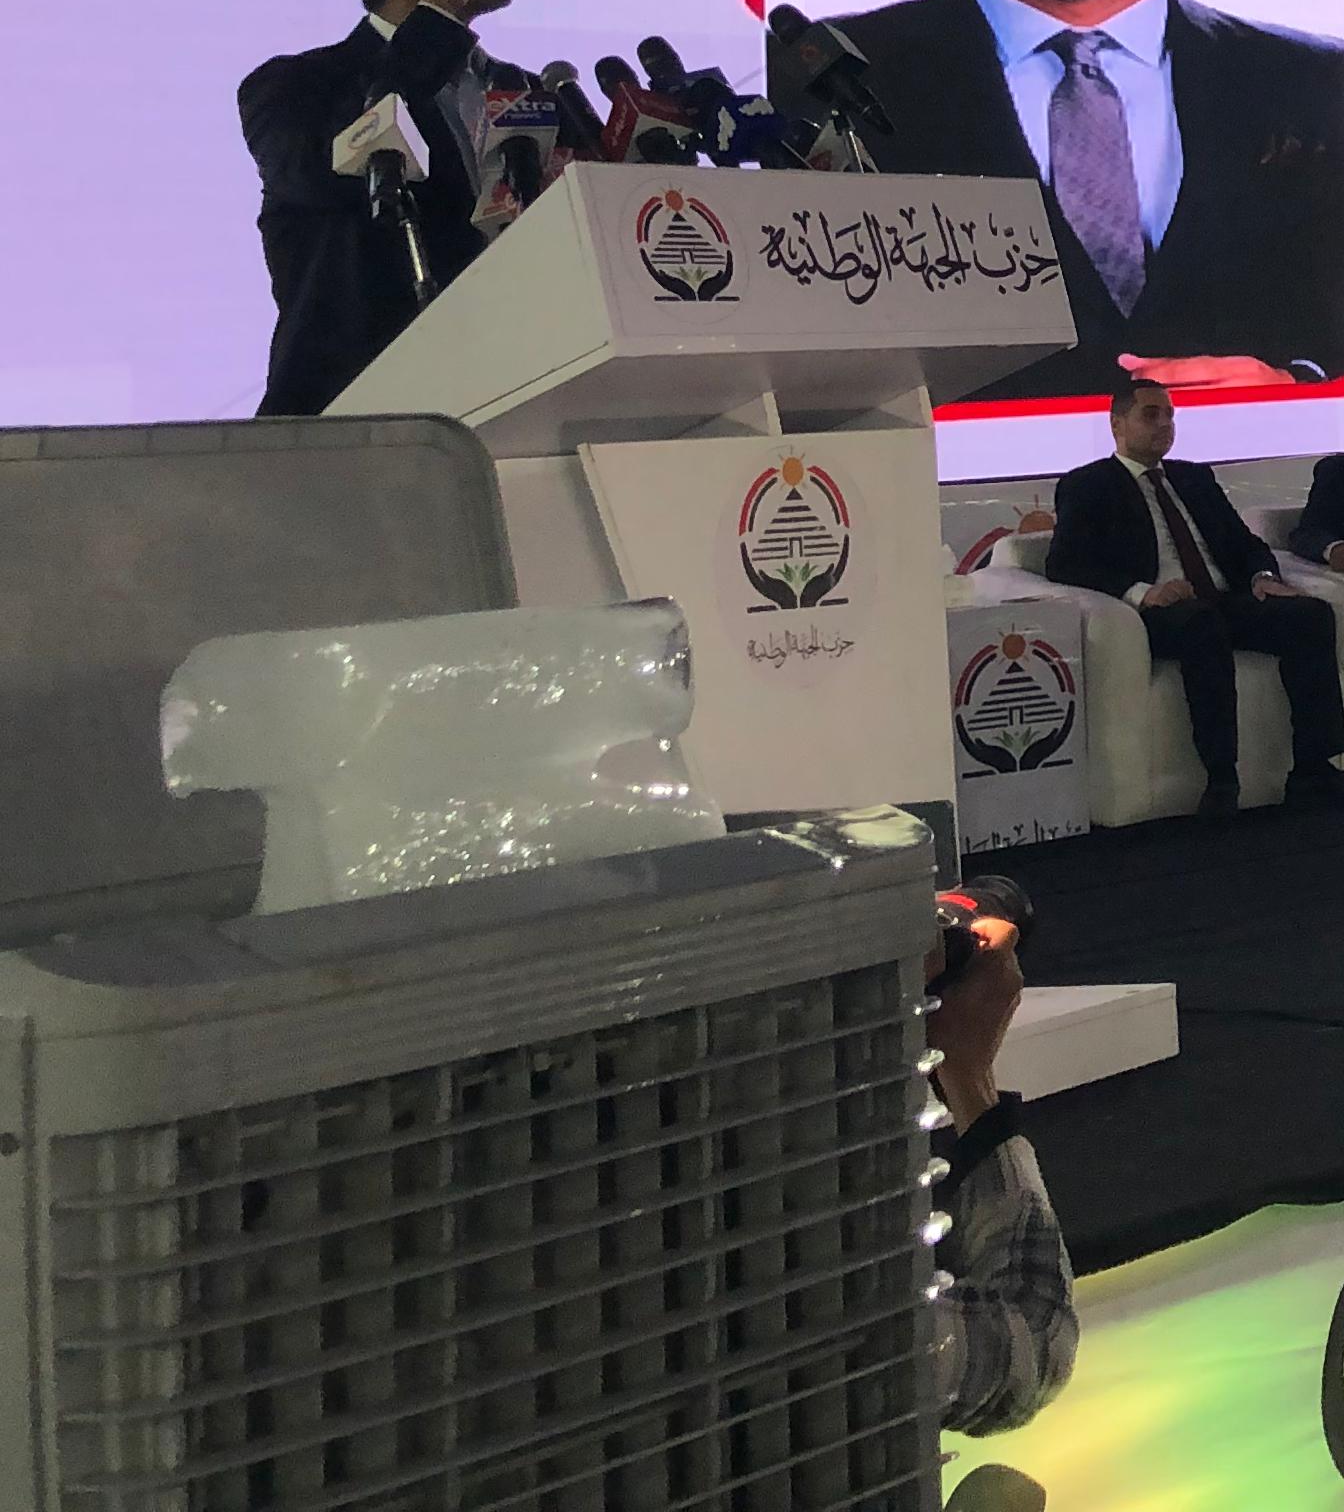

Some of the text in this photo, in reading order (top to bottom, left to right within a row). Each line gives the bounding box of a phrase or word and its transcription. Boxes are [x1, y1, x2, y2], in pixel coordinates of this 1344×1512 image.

[759, 202, 1060, 306] حزب الجبهة الوطنية
